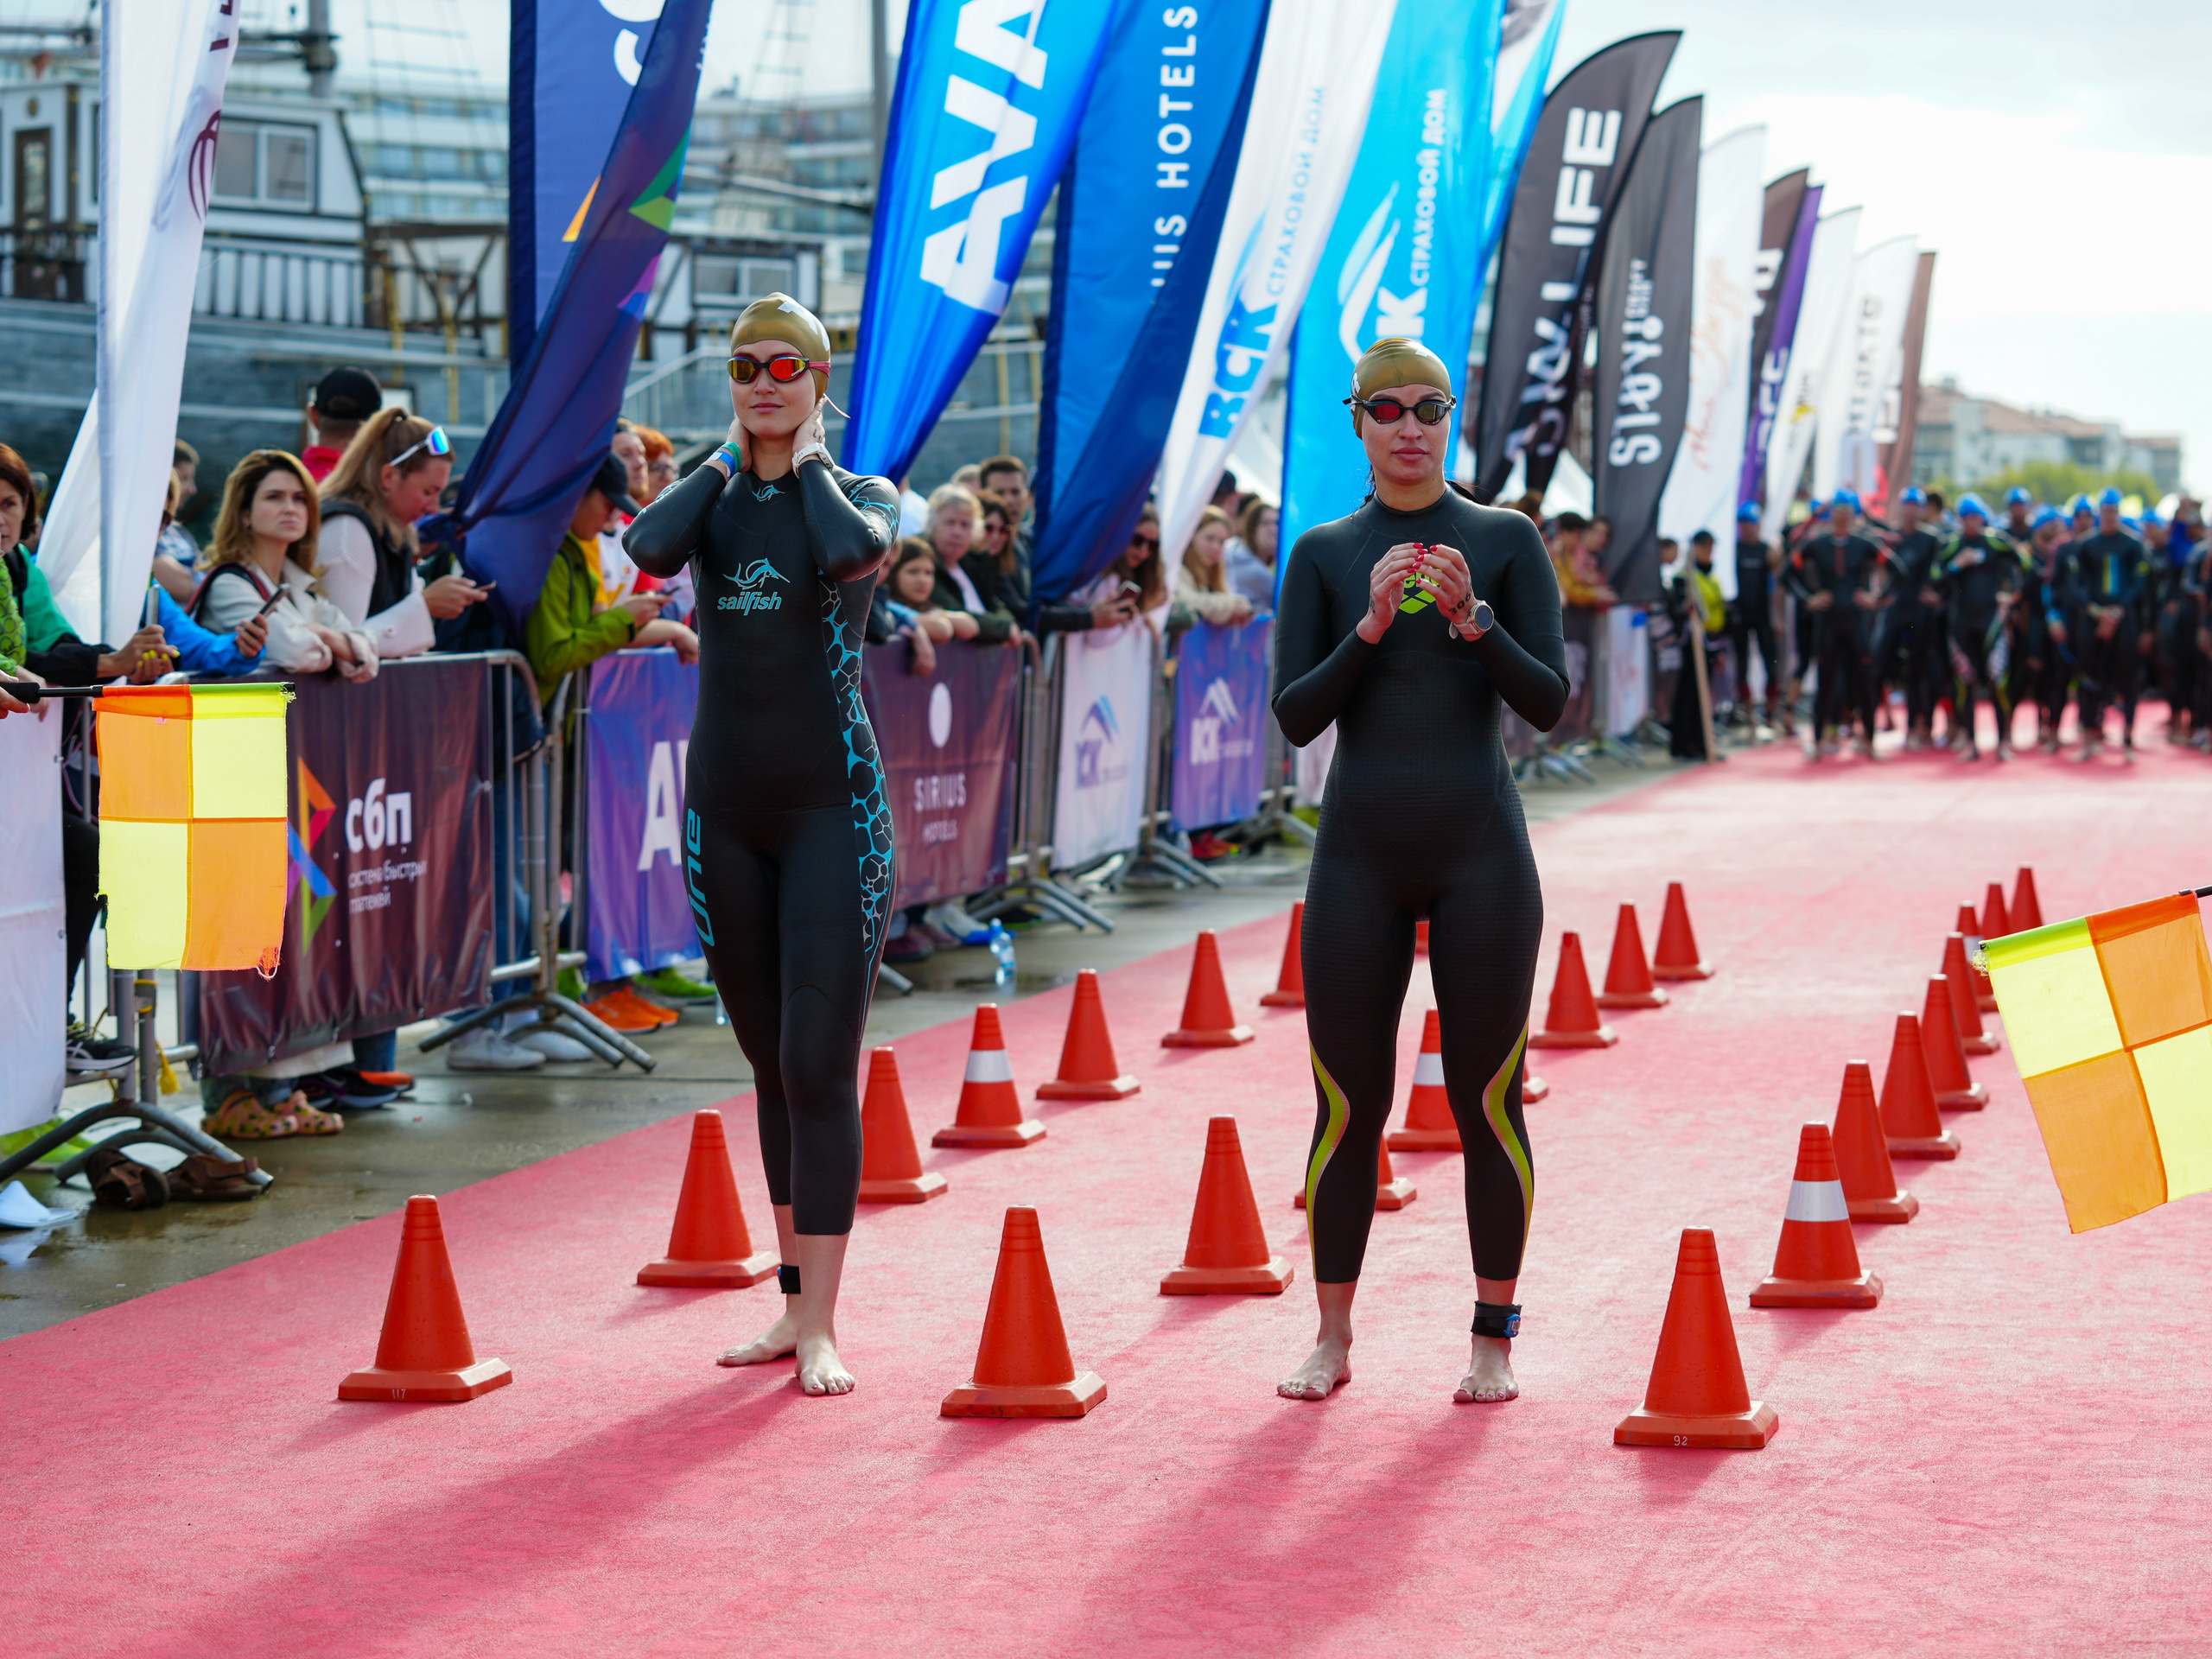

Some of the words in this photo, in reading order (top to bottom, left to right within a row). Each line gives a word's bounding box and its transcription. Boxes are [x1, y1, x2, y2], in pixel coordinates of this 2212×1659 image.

[1156, 5, 1198, 188] HOTELS
[1421, 88, 1448, 146] ДОМ
[1266, 152, 1314, 297] СТРАХОВОЙ
[1301, 87, 1325, 145] ДОМ
[1409, 149, 1441, 286] СТРАХОВОЙ
[717, 591, 782, 616] sailfish
[1449, 591, 1471, 616] 306
[345, 777, 412, 855] сбп
[914, 772, 967, 812] SIRIUS
[1674, 1434, 1688, 1446] 92
